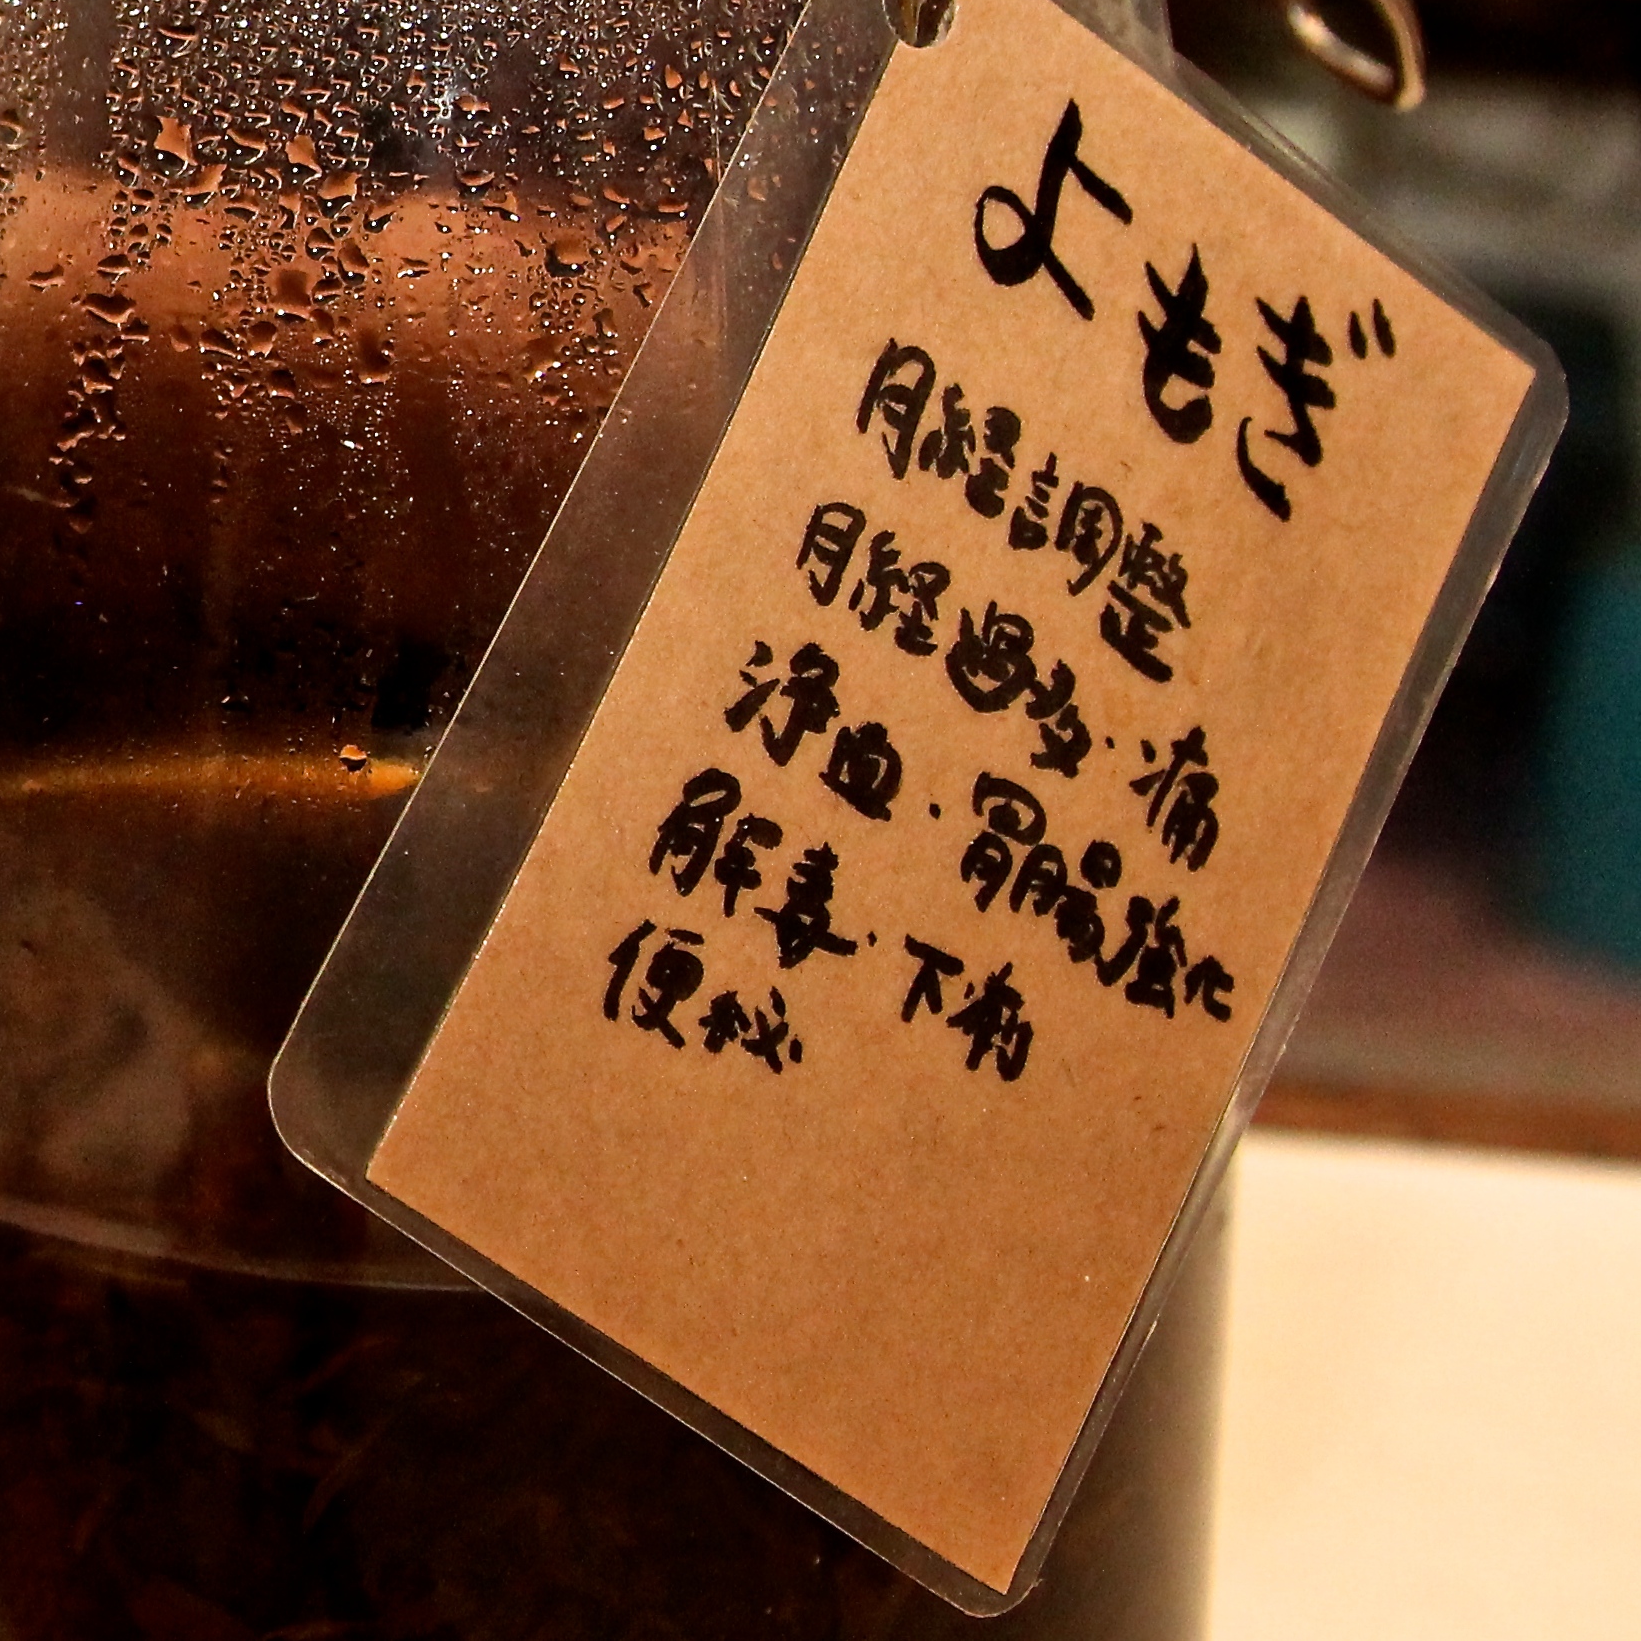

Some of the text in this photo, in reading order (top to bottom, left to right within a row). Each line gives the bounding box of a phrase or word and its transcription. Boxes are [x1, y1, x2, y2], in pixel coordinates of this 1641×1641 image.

[974, 98, 1395, 523] よもぎ
[856, 338, 1191, 682] 月経調整
[603, 919, 803, 1075] 便秘
